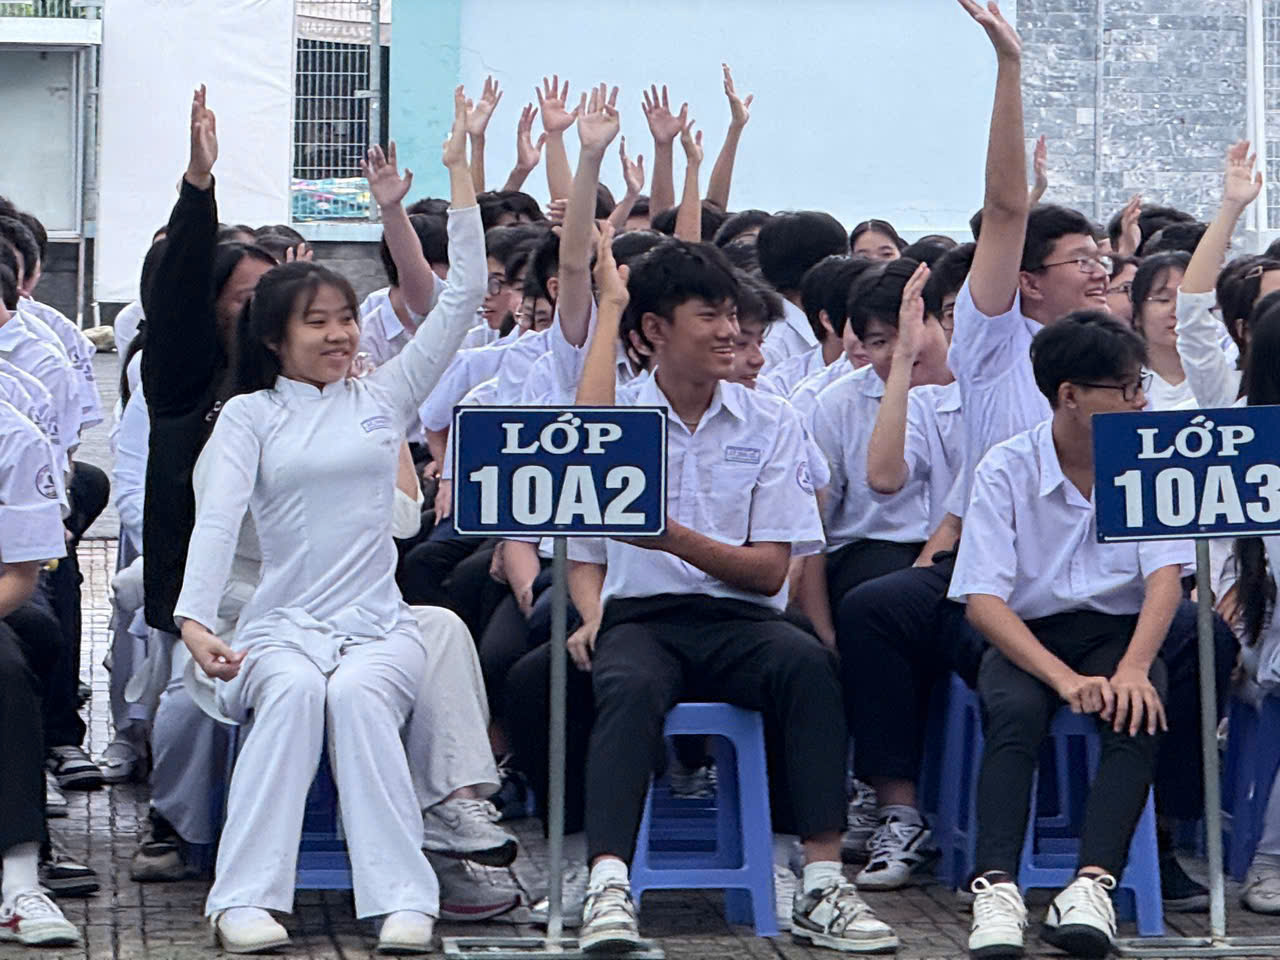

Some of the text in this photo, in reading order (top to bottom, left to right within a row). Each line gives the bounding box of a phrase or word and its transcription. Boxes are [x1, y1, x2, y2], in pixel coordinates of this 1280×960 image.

[501, 412, 623, 454] LỚP
[1136, 415, 1255, 459] LỚP
[469, 465, 646, 525] 10A2
